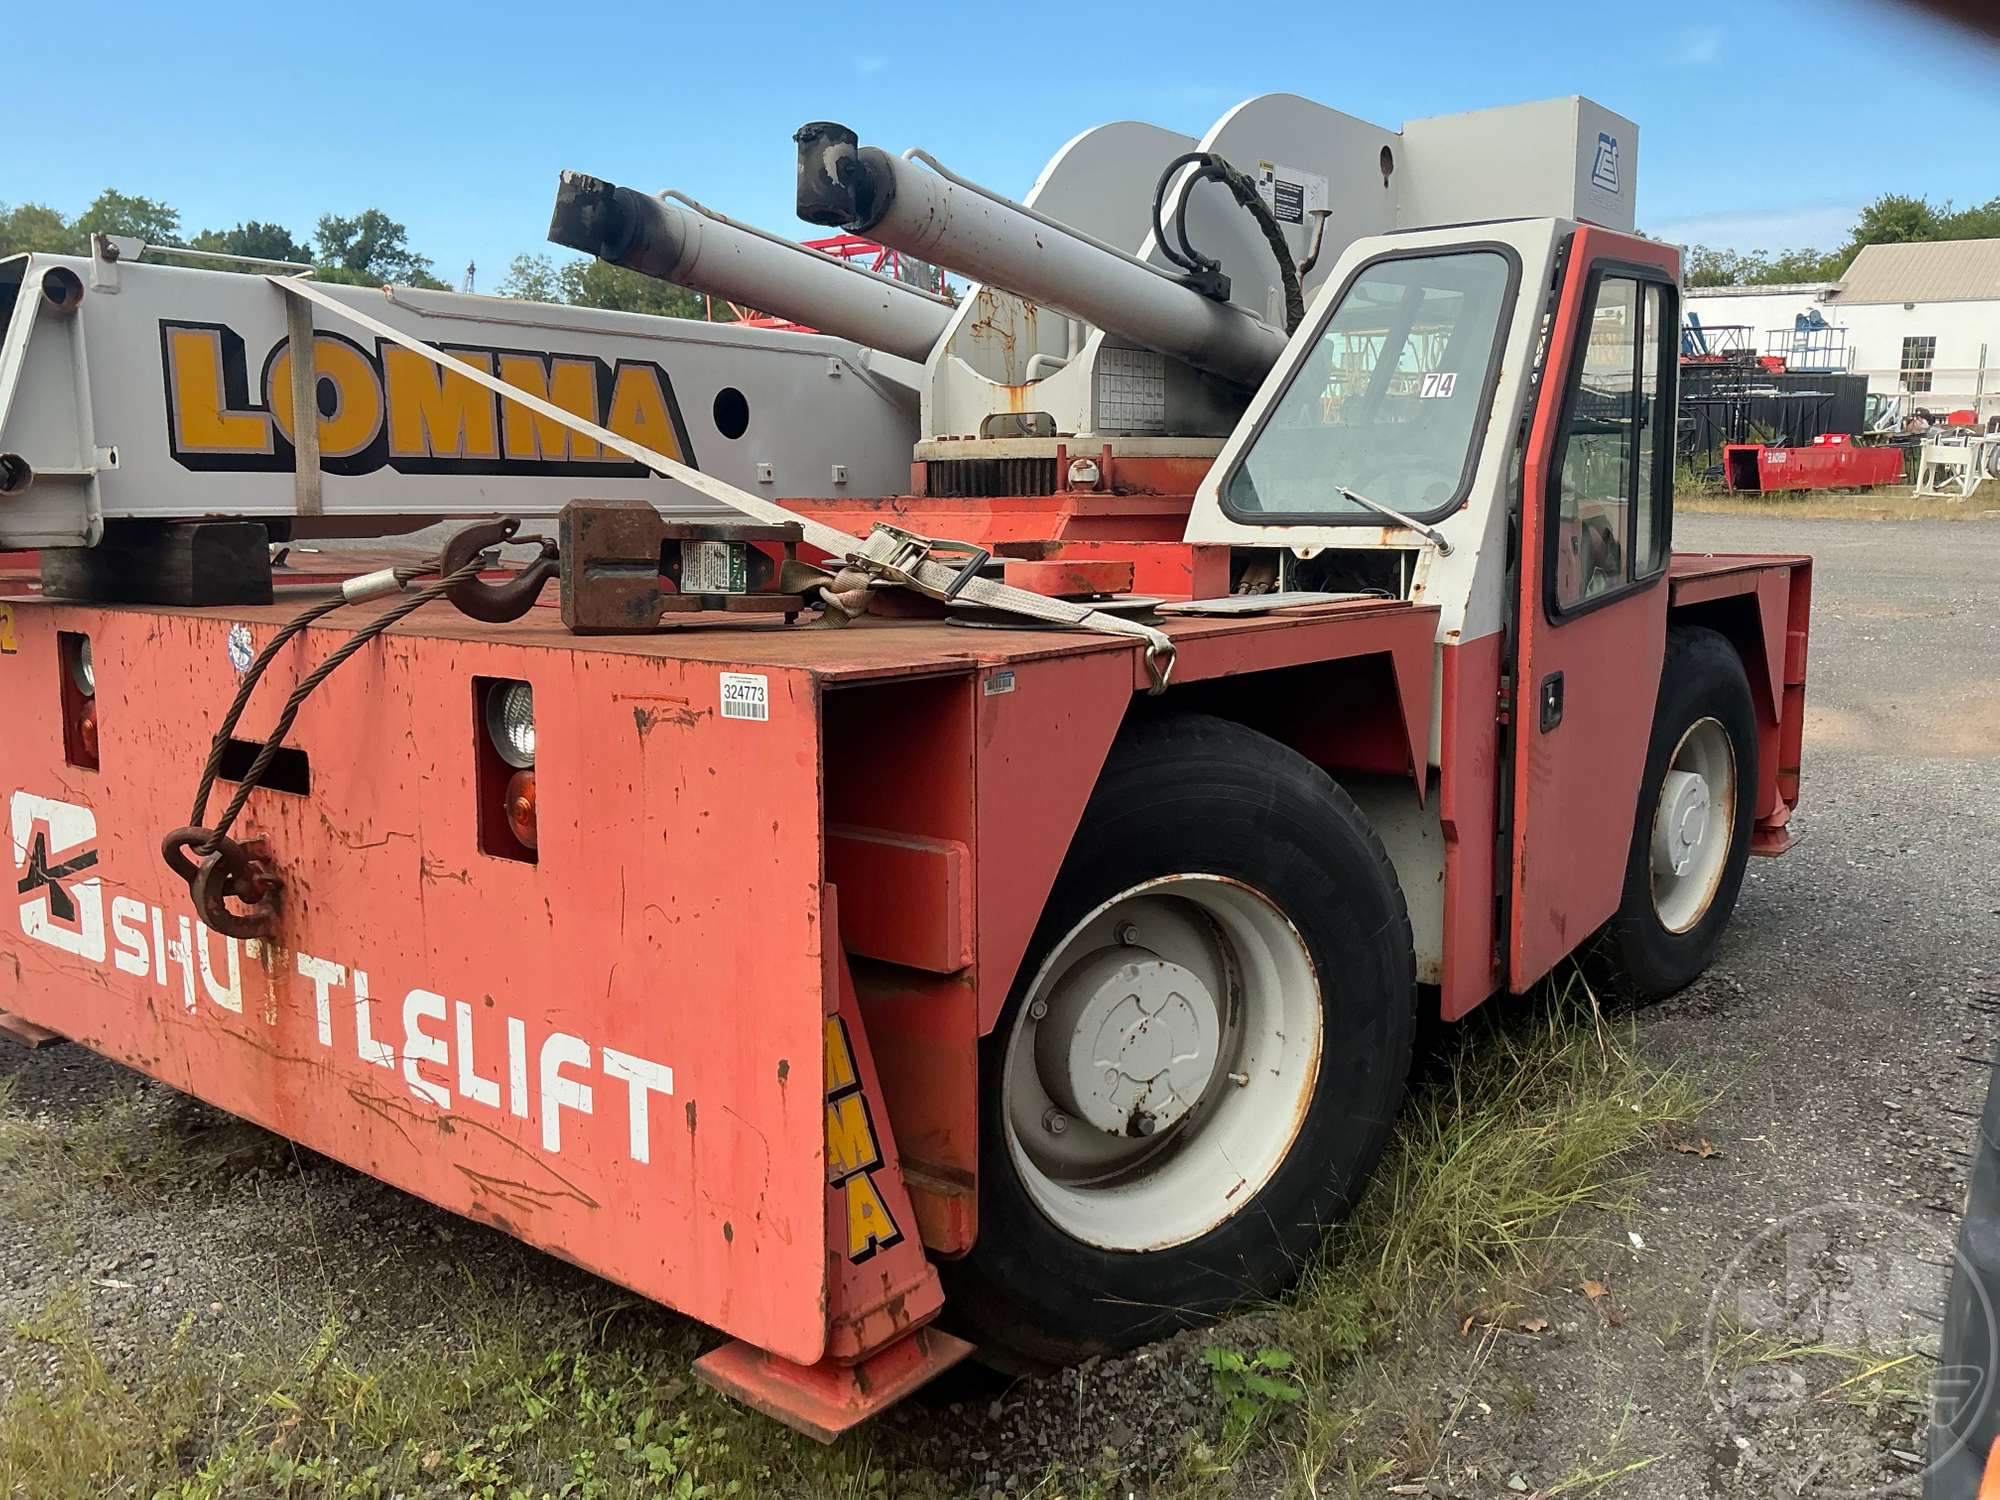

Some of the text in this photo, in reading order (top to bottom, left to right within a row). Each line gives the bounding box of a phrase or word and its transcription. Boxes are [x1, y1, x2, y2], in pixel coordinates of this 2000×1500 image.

[1424, 374, 1454, 397] 74
[160, 319, 699, 478] LOMMA
[724, 683, 765, 702] 324773
